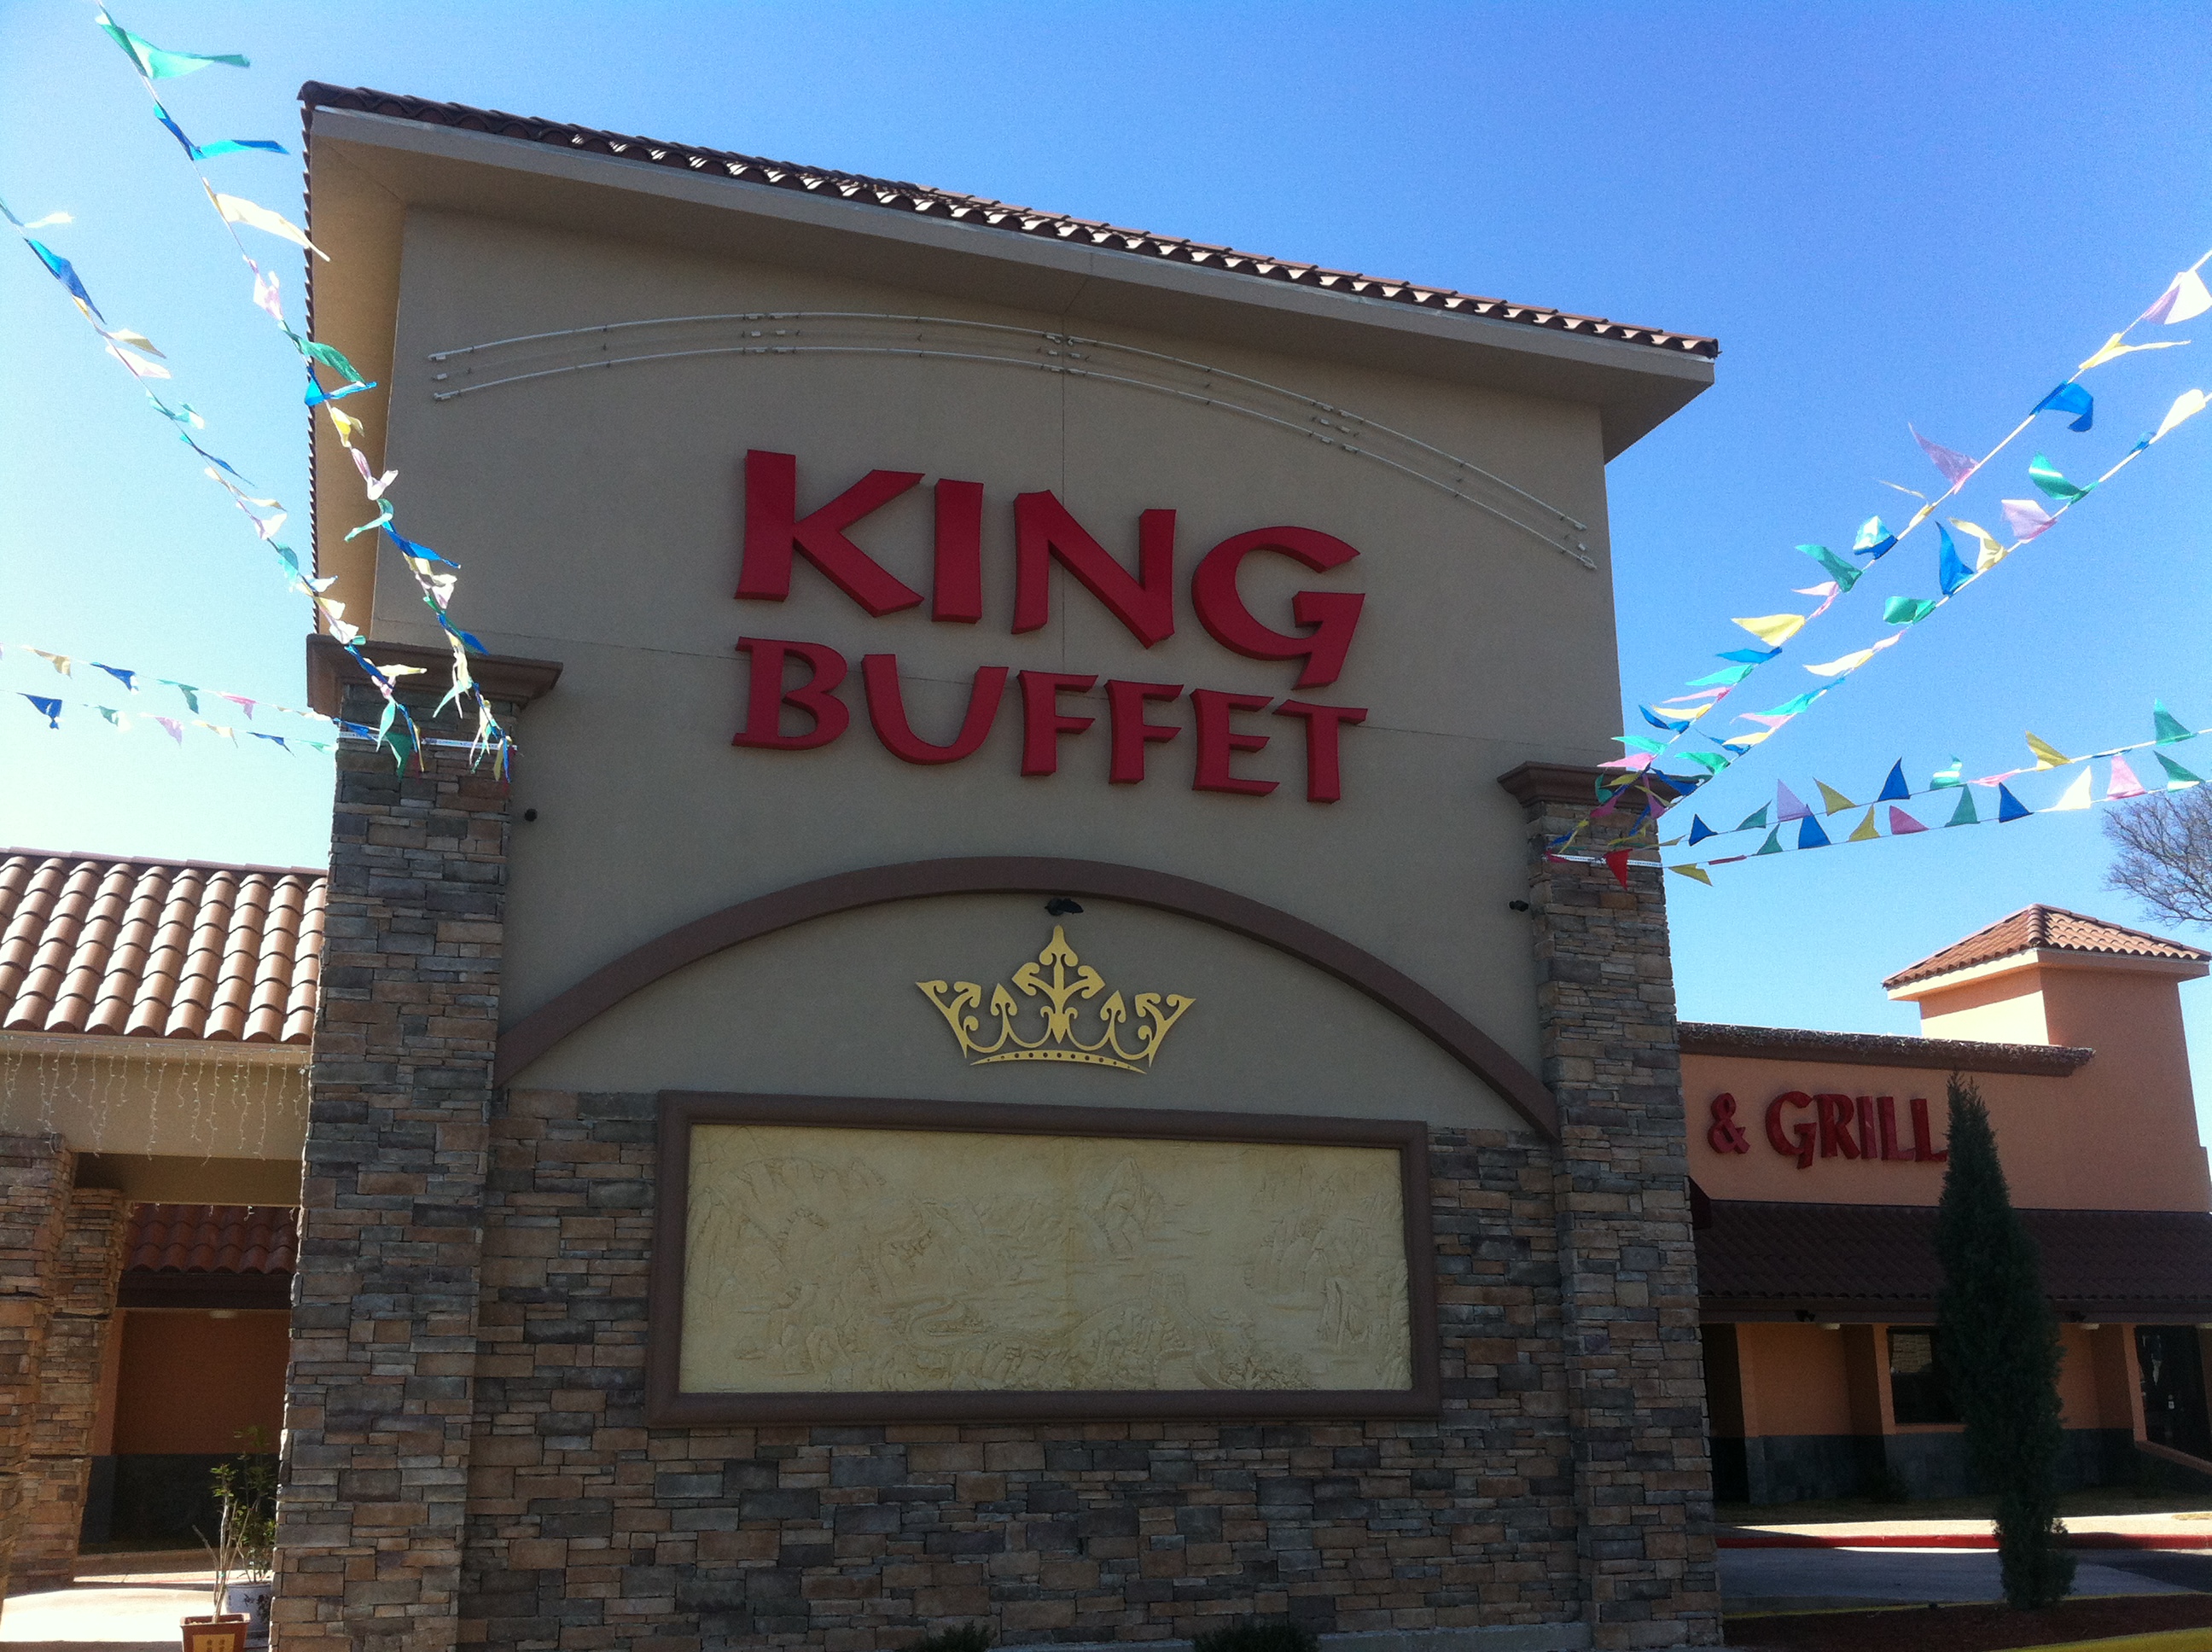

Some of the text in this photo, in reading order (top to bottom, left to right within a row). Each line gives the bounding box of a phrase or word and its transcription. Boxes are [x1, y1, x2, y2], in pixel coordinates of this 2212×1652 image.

[733, 449, 1365, 690] KING
[731, 637, 1368, 805] BUFFET
[1708, 1091, 1948, 1170] & GRILL
